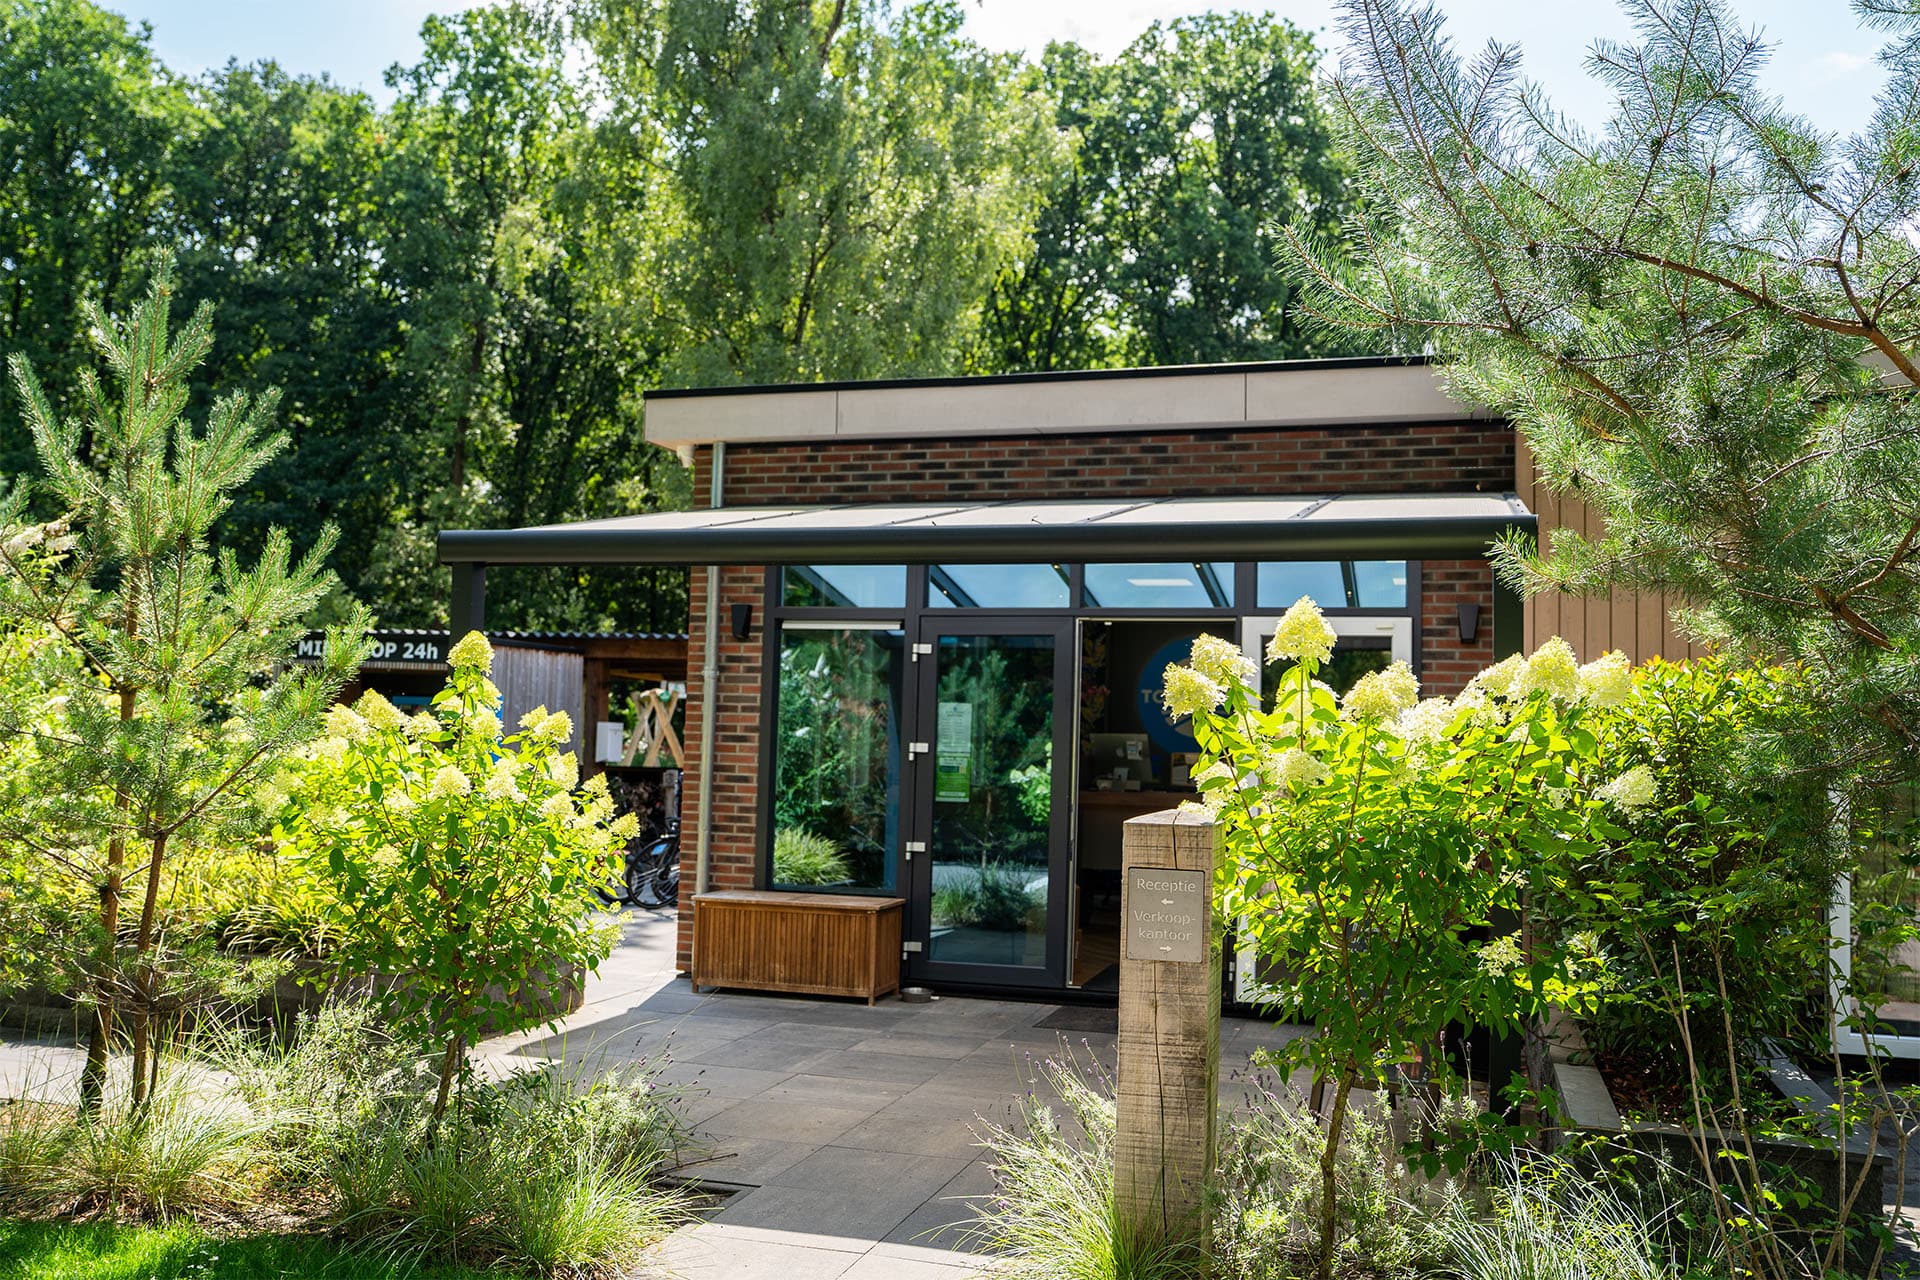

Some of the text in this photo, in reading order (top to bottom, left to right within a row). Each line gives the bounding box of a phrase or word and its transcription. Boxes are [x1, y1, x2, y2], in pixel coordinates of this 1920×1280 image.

[402, 642, 438, 659] 24h
[1136, 878, 1196, 894] Receptie
[1133, 910, 1196, 926] Verkoop-
[1138, 927, 1192, 941] kantoor
